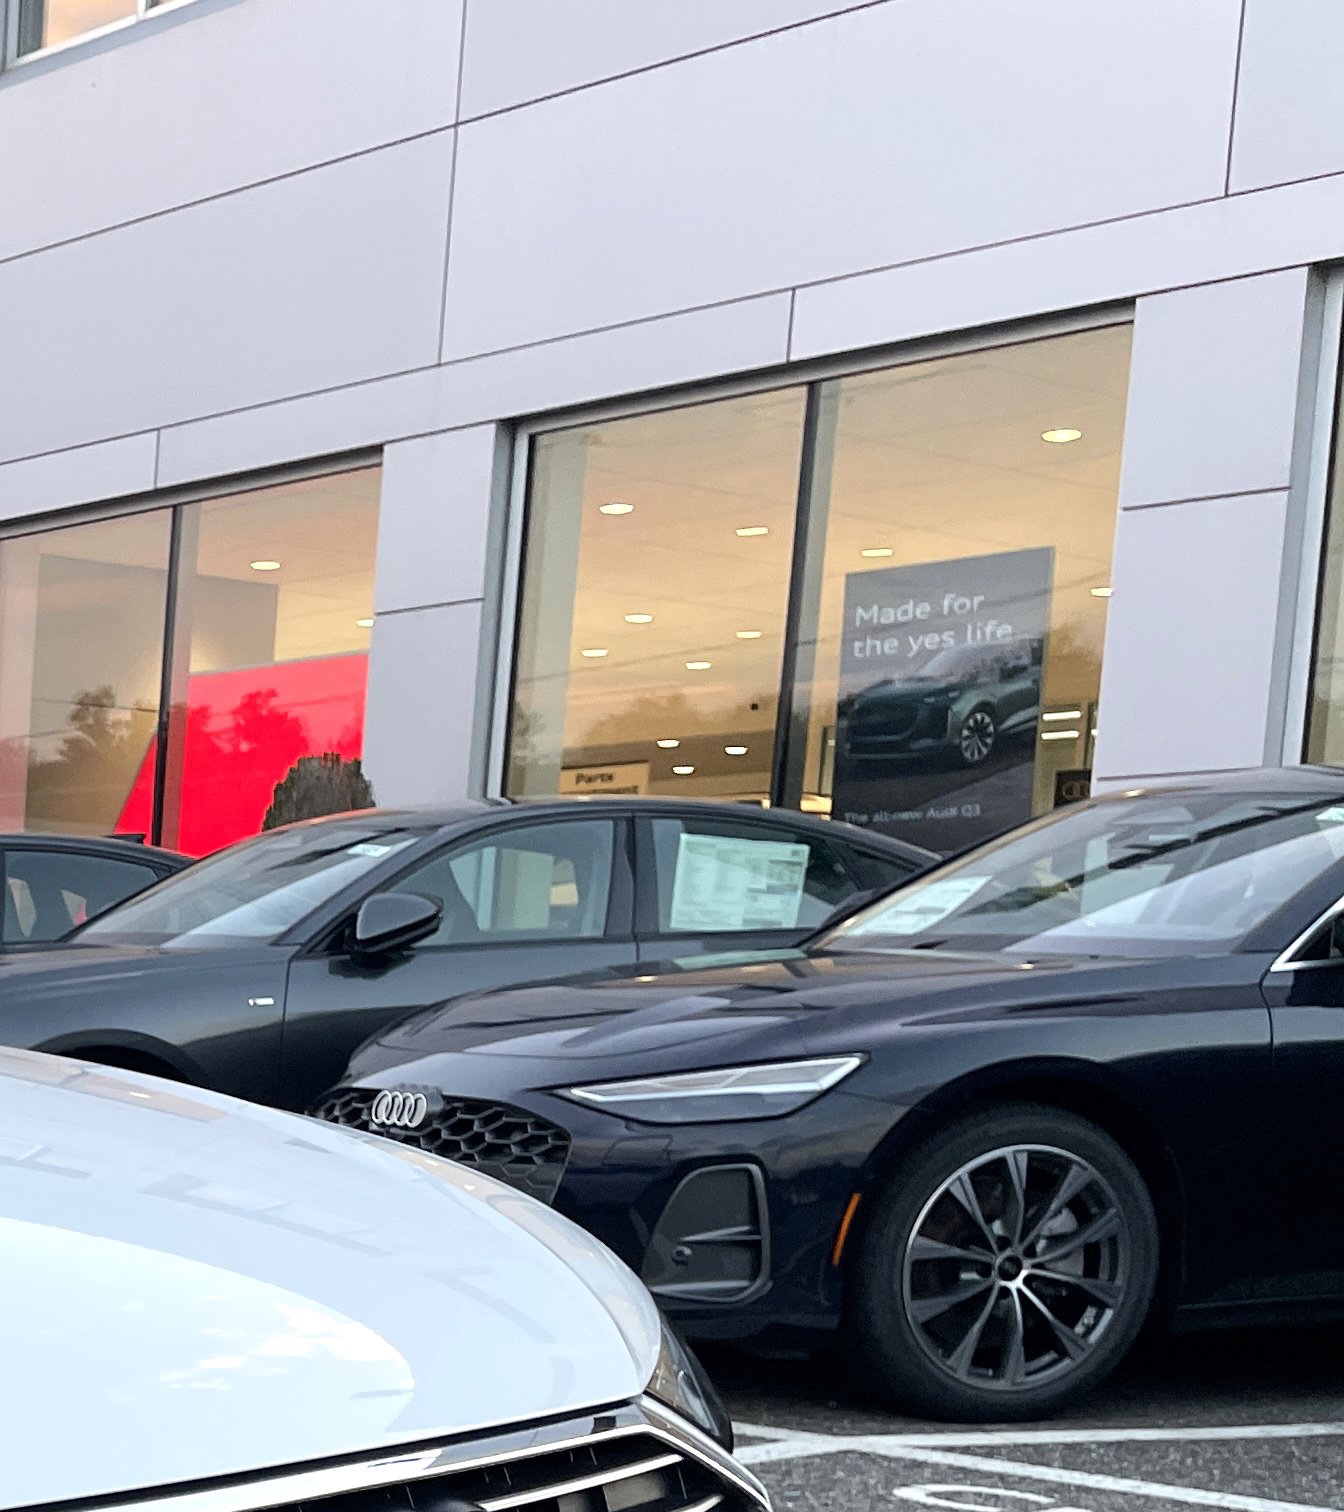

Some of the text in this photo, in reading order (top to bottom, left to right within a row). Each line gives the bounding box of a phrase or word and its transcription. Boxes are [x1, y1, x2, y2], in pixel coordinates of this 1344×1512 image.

[854, 592, 985, 628] Made for
[853, 618, 1012, 658] the yes life
